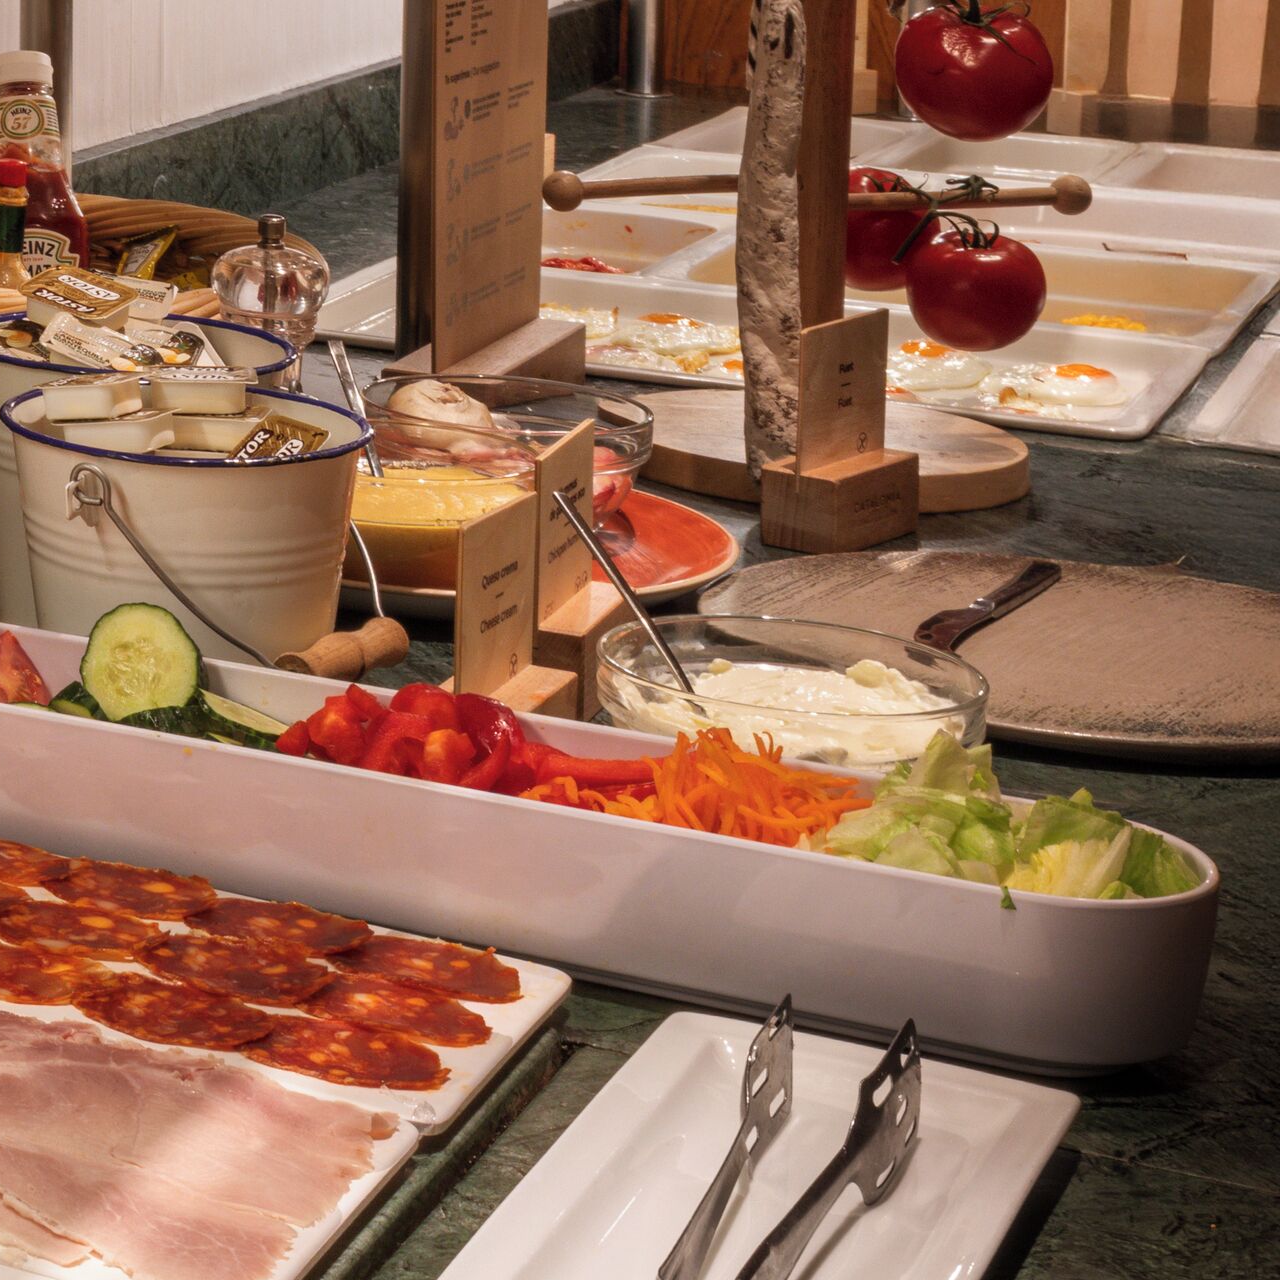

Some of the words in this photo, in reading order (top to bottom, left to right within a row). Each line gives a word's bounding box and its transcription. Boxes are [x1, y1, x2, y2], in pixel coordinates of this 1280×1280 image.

[10, 107, 32, 116] HEINZ
[11, 116, 32, 130] 57
[22, 240, 55, 257] EINZ
[236, 430, 271, 459] TOR
